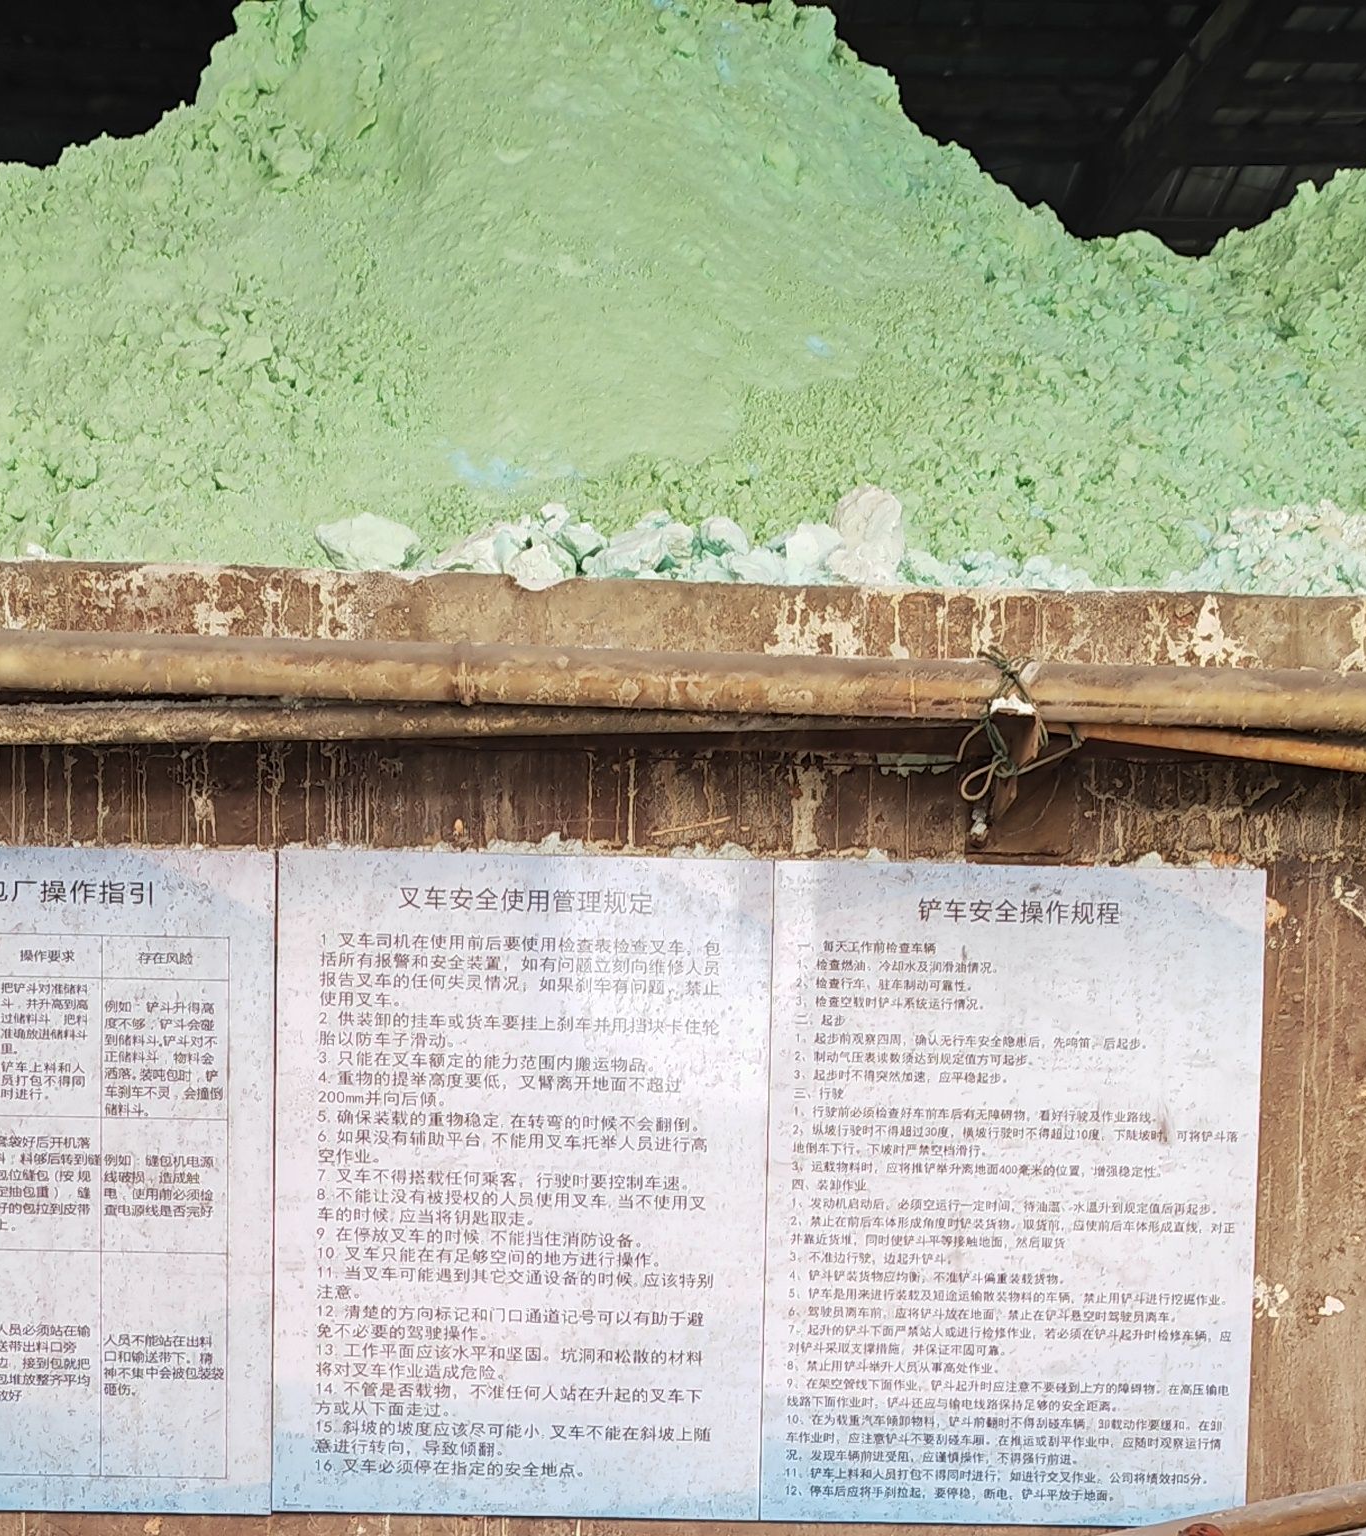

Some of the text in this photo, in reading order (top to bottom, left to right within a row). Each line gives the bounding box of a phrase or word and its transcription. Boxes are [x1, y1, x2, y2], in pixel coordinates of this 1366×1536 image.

[398, 887, 653, 916] 叉车安全使用管理规定
[919, 898, 1121, 926] 铲车安全操作规程
[20, 950, 75, 962] 操作要求
[138, 952, 193, 965] 存在风险
[1, 982, 88, 995] 把铲斗对准储料
[319, 991, 401, 1007] 使用叉车。
[1, 1028, 88, 1041] 准确放进储料斗
[318, 1031, 455, 1048] 胎以防车子滑动。
[1, 1061, 85, 1074] 铲车上料和人
[1, 1075, 86, 1088] 员打包不得同
[318, 1091, 446, 1107] 200mm并向后倾。
[793, 1087, 844, 1100] 三、行驶
[318, 1149, 380, 1164] 空作业。
[792, 1178, 866, 1191] 四、装卸作业
[103, 1204, 214, 1218] 查电源线是否完好
[316, 1284, 362, 1300] 注意。
[316, 1323, 488, 1341] 免不必要的驾驶操作。
[103, 1334, 212, 1348] 人员不能站在出料
[316, 1361, 506, 1380] 将对叉车作业造成危险。
[315, 1400, 450, 1418] 方或从下面走过。
